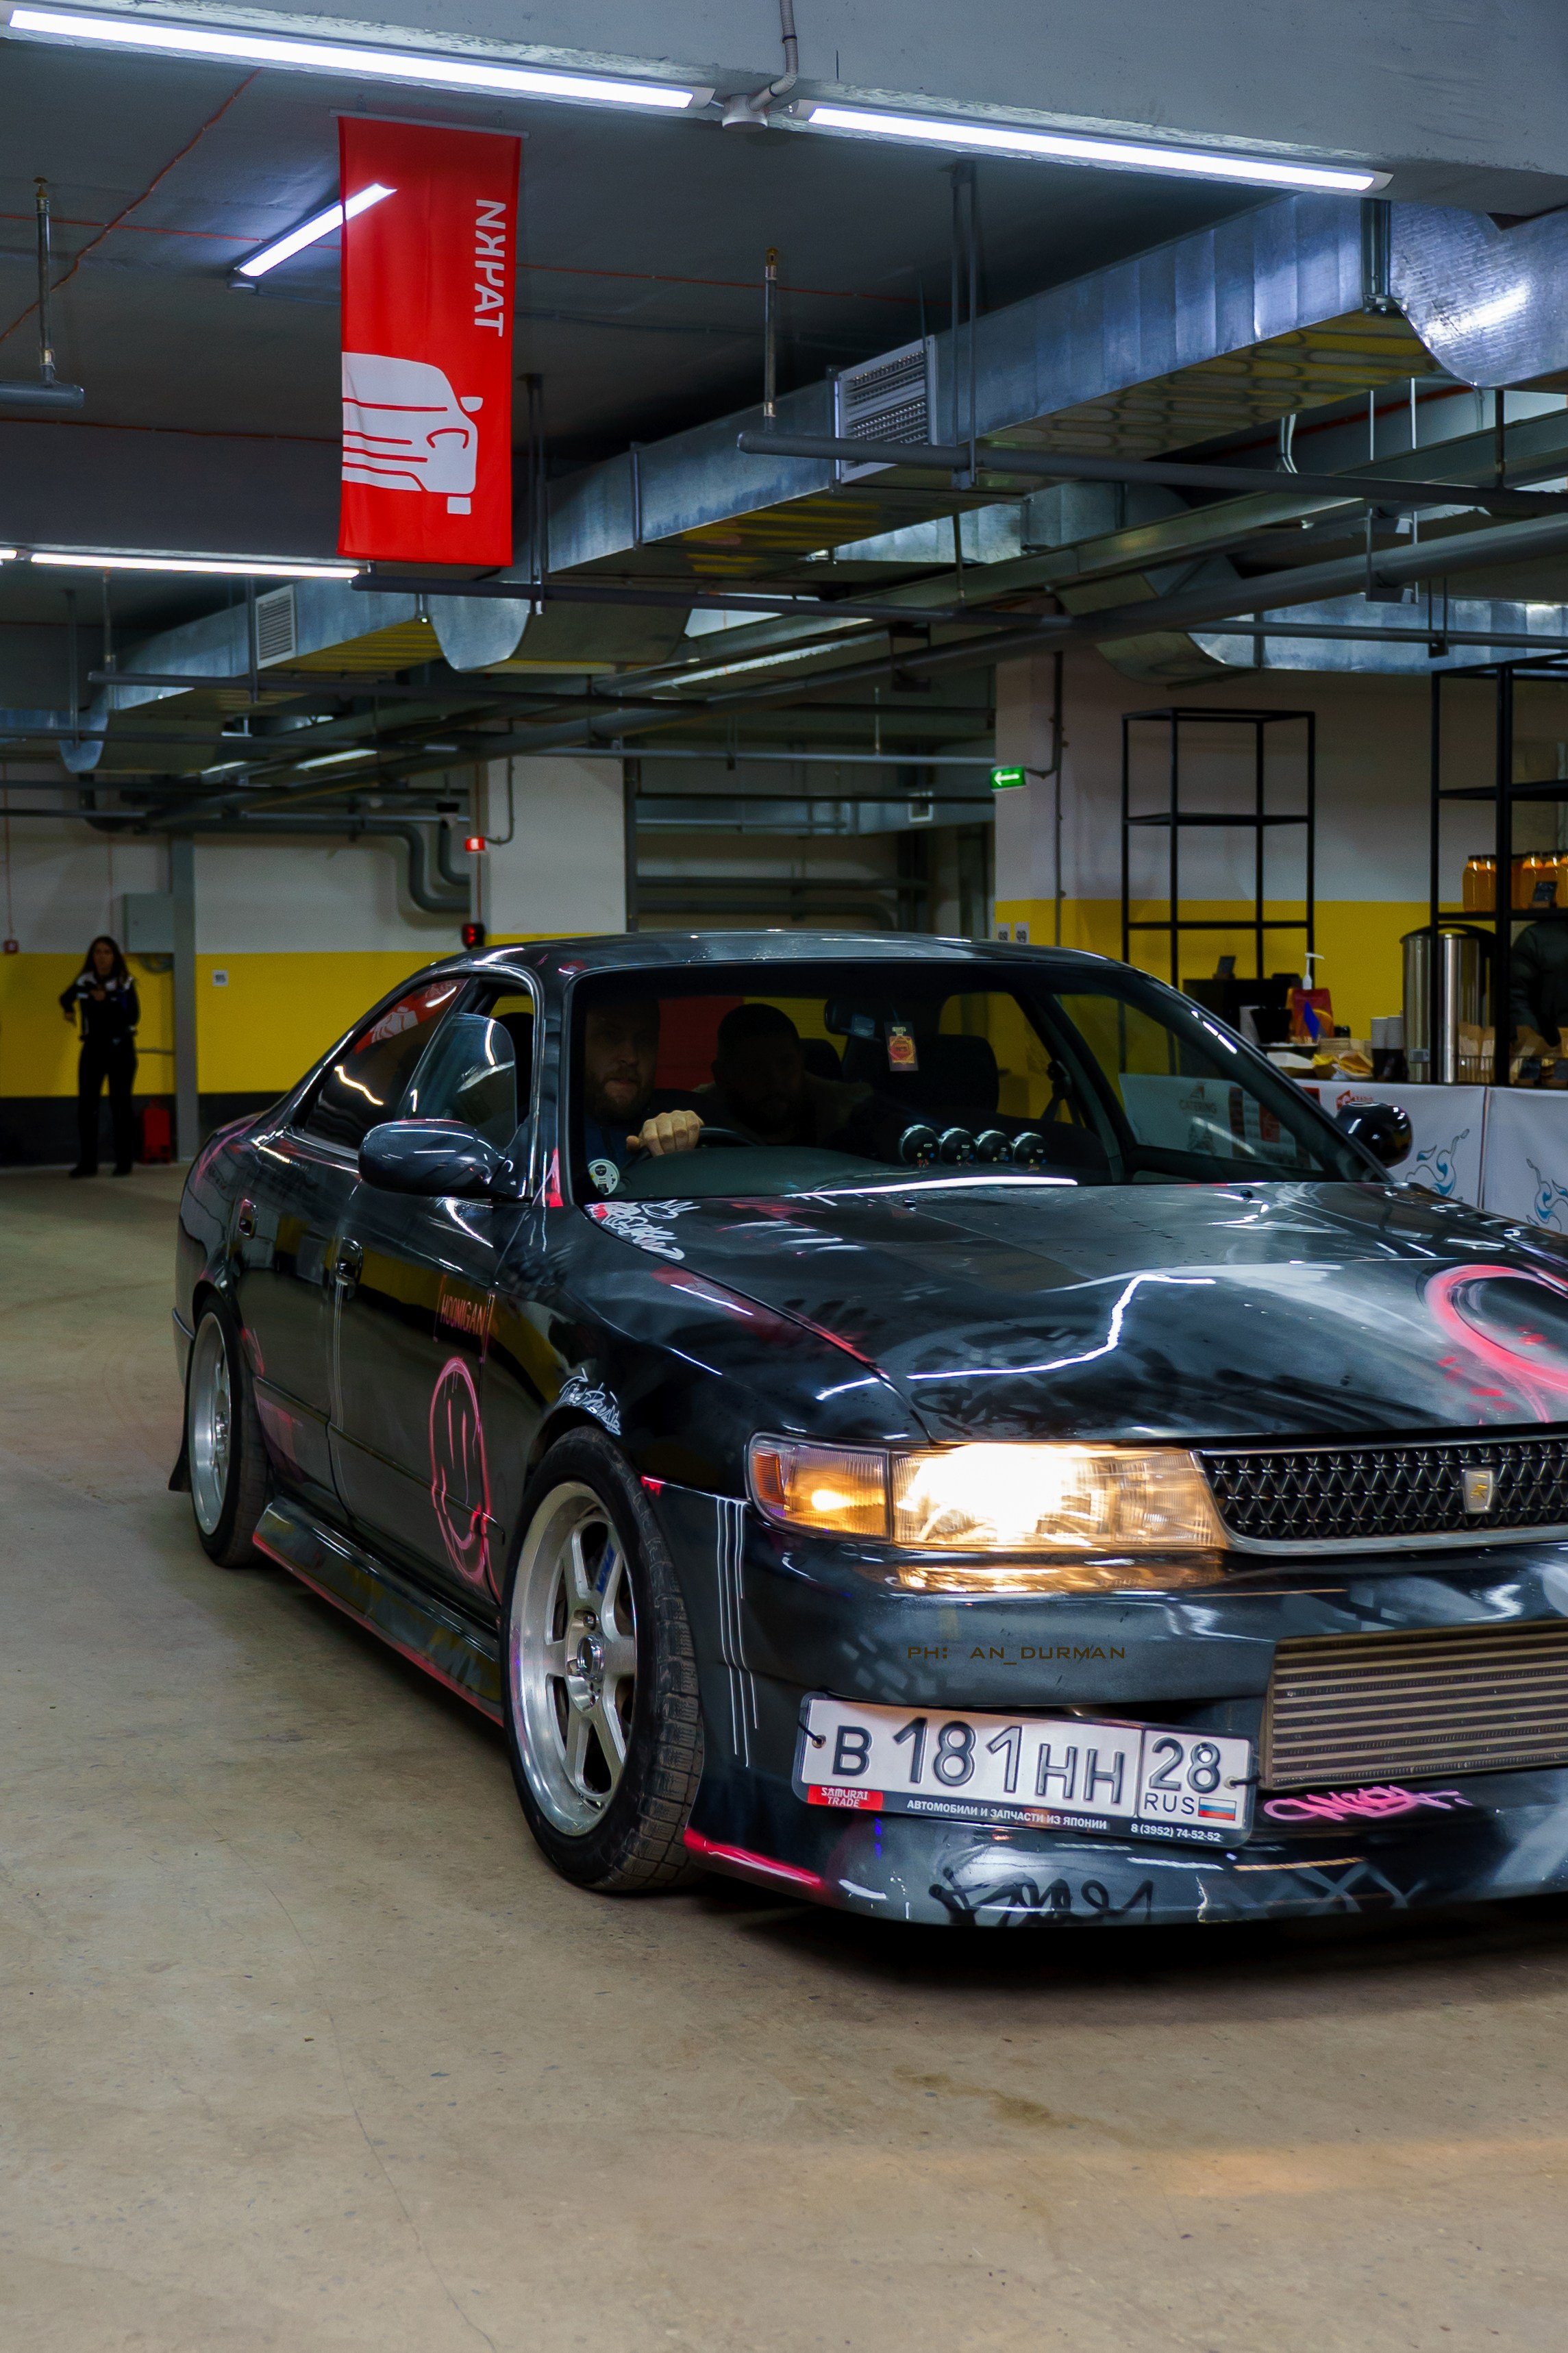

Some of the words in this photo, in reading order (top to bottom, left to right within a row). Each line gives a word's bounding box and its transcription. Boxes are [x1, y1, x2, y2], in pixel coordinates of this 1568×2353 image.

[440, 1294, 487, 1335] HOONIGAN
[1149, 1736, 1221, 1793] 28
[821, 1787, 869, 1800] SAMURAI
[827, 1797, 860, 1808] TRADE
[1144, 1793, 1195, 1815] RUS
[907, 1799, 978, 1816] АВТОМОБИЛИ
[980, 1808, 988, 1816] И
[990, 1809, 1044, 1823] ЗАПЧАСТИ
[1047, 1816, 1060, 1824] ИЗ
[1062, 1817, 1107, 1830] ЯПОНИИ
[1130, 1824, 1138, 1832] 8
[1140, 1825, 1173, 1837] (3952)
[1176, 1829, 1221, 1841] 74-52-52
